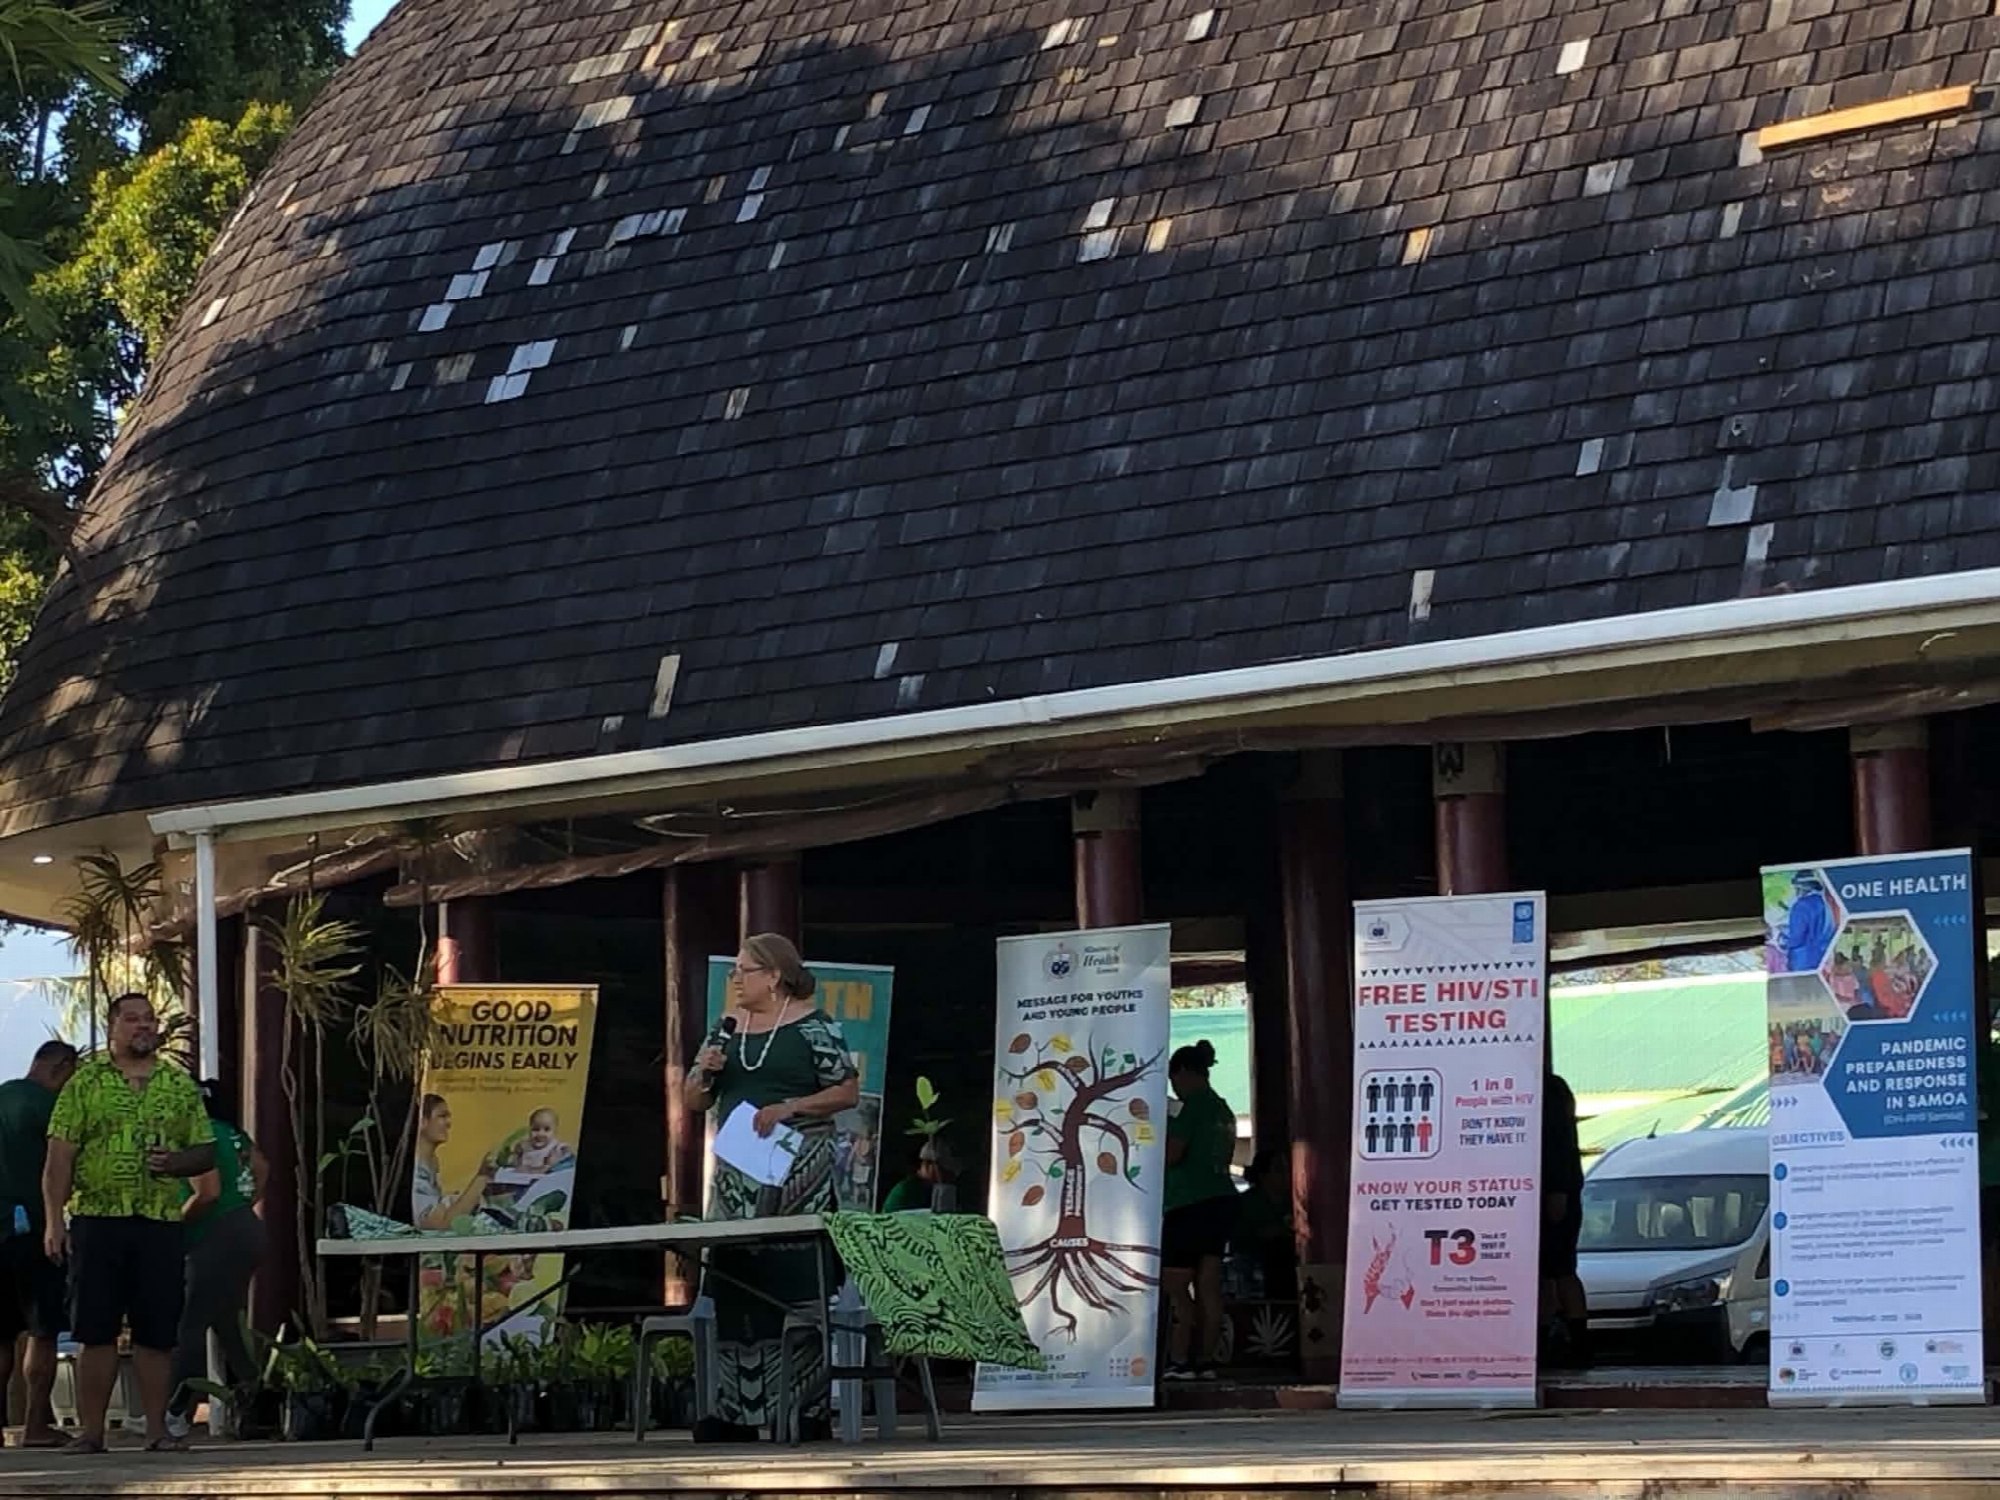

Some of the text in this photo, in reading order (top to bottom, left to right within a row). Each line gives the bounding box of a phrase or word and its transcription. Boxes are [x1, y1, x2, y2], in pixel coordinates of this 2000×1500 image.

[1841, 874, 1967, 899] ONE HEALTH
[1017, 989, 1144, 1008] MESSAGE FOR YOUTHS
[1359, 979, 1539, 1007] FREE HIV/STI
[471, 1000, 552, 1022] GOOD
[1022, 1003, 1136, 1021] AND YOUNG PEOPLE
[1385, 1010, 1507, 1033] TESTING
[440, 1024, 578, 1046] NUTRITION
[1881, 1037, 1967, 1055] PANDEMIC
[511, 1052, 579, 1070] EARLY
[1845, 1056, 1967, 1074] PREPAREDNESS
[1471, 1079, 1478, 1091] 1
[1504, 1077, 1514, 1090] 8
[1846, 1073, 1967, 1093] AND RESPONSE
[1886, 1092, 1968, 1109] IN SAMOA
[1494, 1116, 1526, 1128] KNOW
[1459, 1133, 1484, 1146] THEY
[1486, 1132, 1514, 1145] HAVE
[1772, 1131, 1845, 1146] OBJECTIVES
[1357, 1177, 1535, 1196] KNOW YOUR STATUS
[1370, 1195, 1517, 1212] GET TESTED TODAY
[1424, 1228, 1477, 1266] T3
